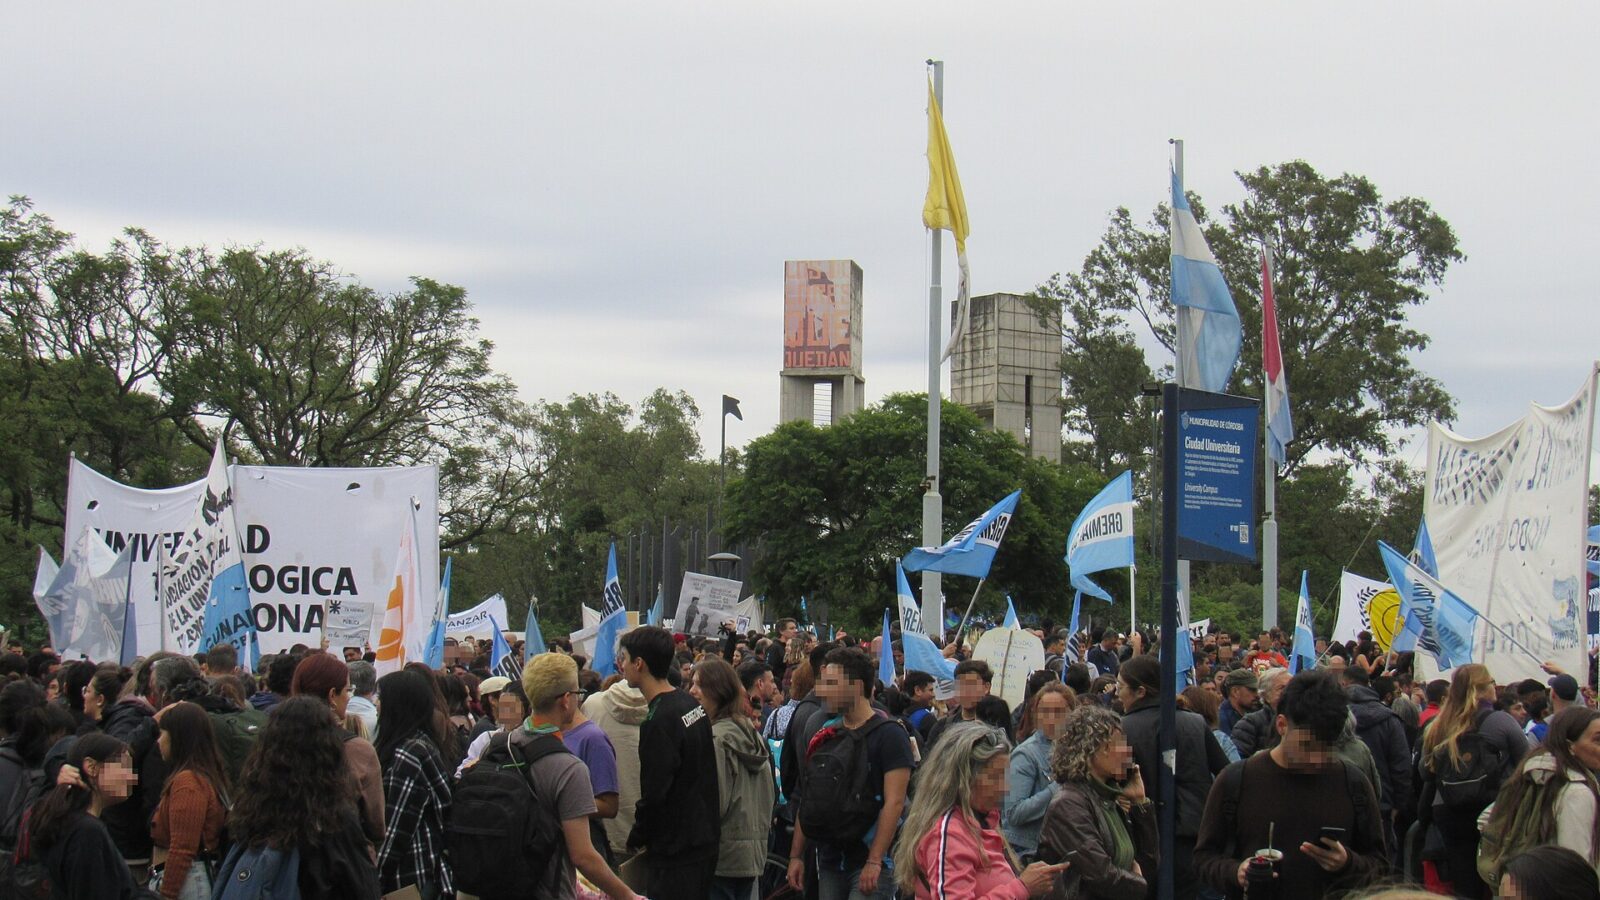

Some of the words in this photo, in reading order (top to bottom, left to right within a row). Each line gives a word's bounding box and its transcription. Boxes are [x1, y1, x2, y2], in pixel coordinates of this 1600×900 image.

[1219, 420, 1225, 429] DE
[1184, 435, 1205, 450] Ciudad
[1205, 437, 1241, 455] Universitaria
[1184, 483, 1203, 494] University
[1202, 483, 1218, 495] Campus
[446, 610, 488, 628] ANZAR
